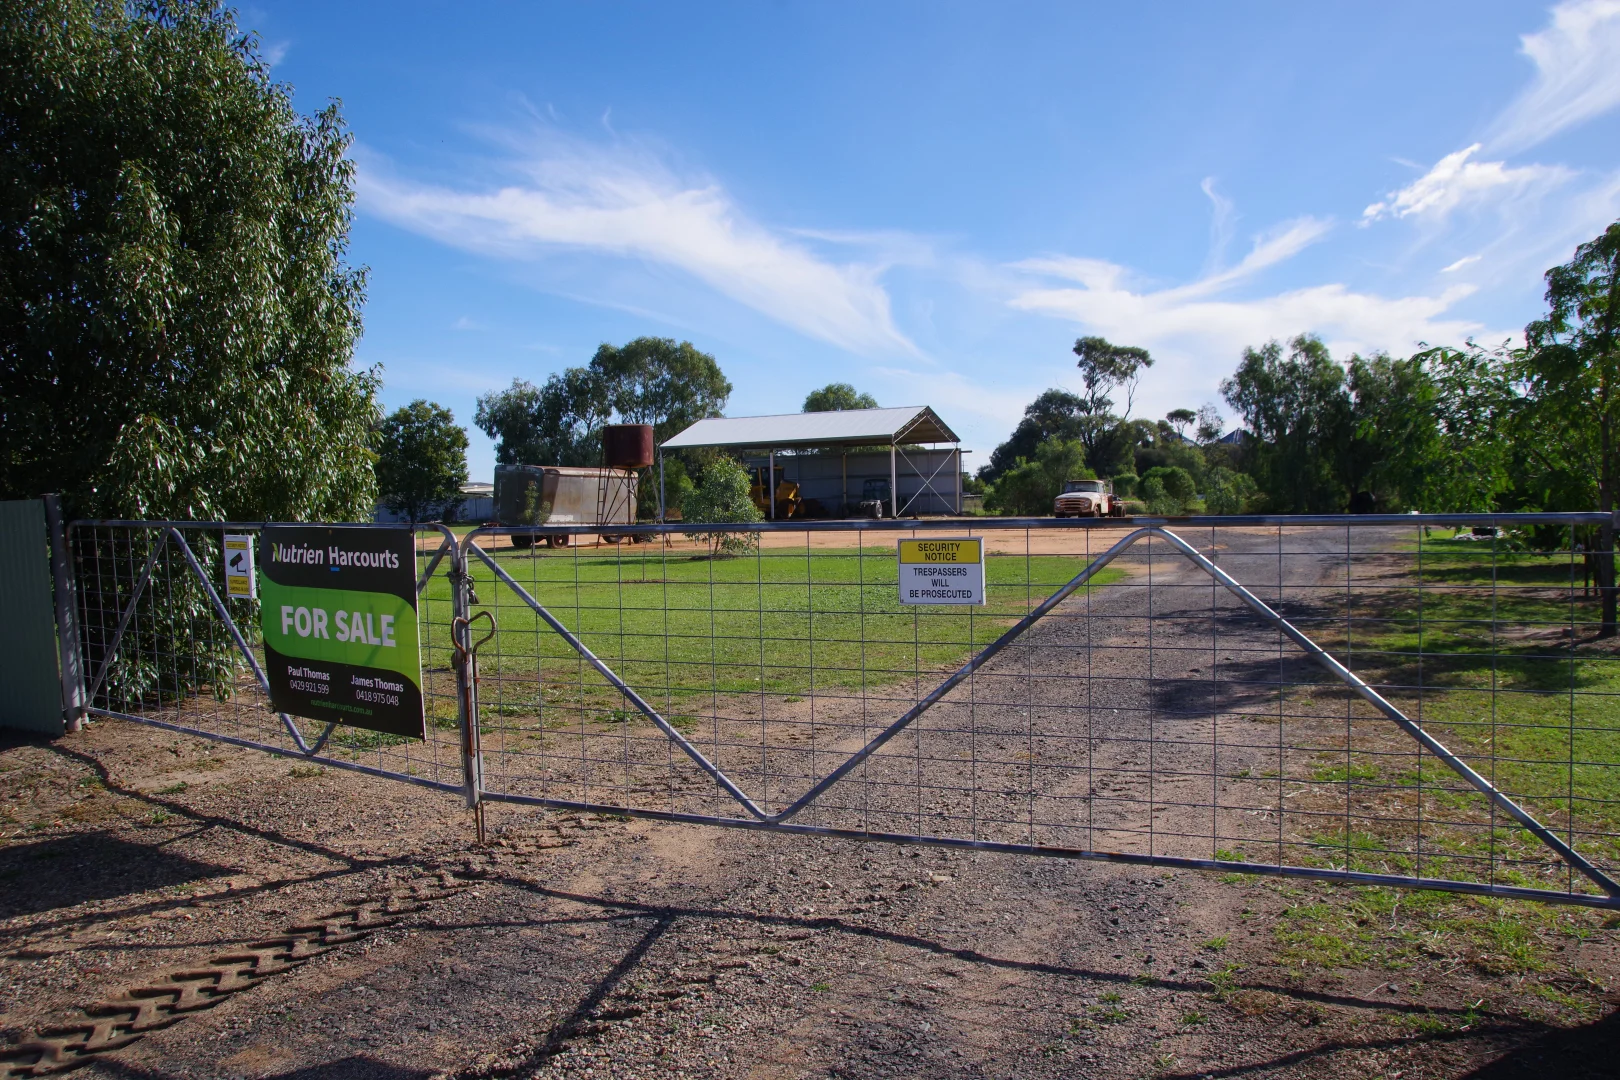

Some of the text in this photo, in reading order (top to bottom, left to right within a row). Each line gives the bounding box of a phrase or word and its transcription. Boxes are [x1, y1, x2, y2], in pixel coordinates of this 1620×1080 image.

[918, 543, 961, 552] SECURITY
[272, 542, 399, 569] Nutrien Harcourts
[925, 552, 957, 561] NOTICE
[913, 567, 968, 577] TRESPASSERS
[931, 578, 950, 588] WILL
[909, 589, 973, 599] BE PROSECUTED
[281, 605, 397, 648] FOR SALE
[287, 665, 330, 681] Paul Thomas
[289, 679, 305, 691] 0429
[305, 682, 317, 692] 921
[350, 674, 404, 693] James Thomas
[355, 689, 399, 706] 0418 975 048
[310, 698, 373, 716] nutrienharcourts.com.au
